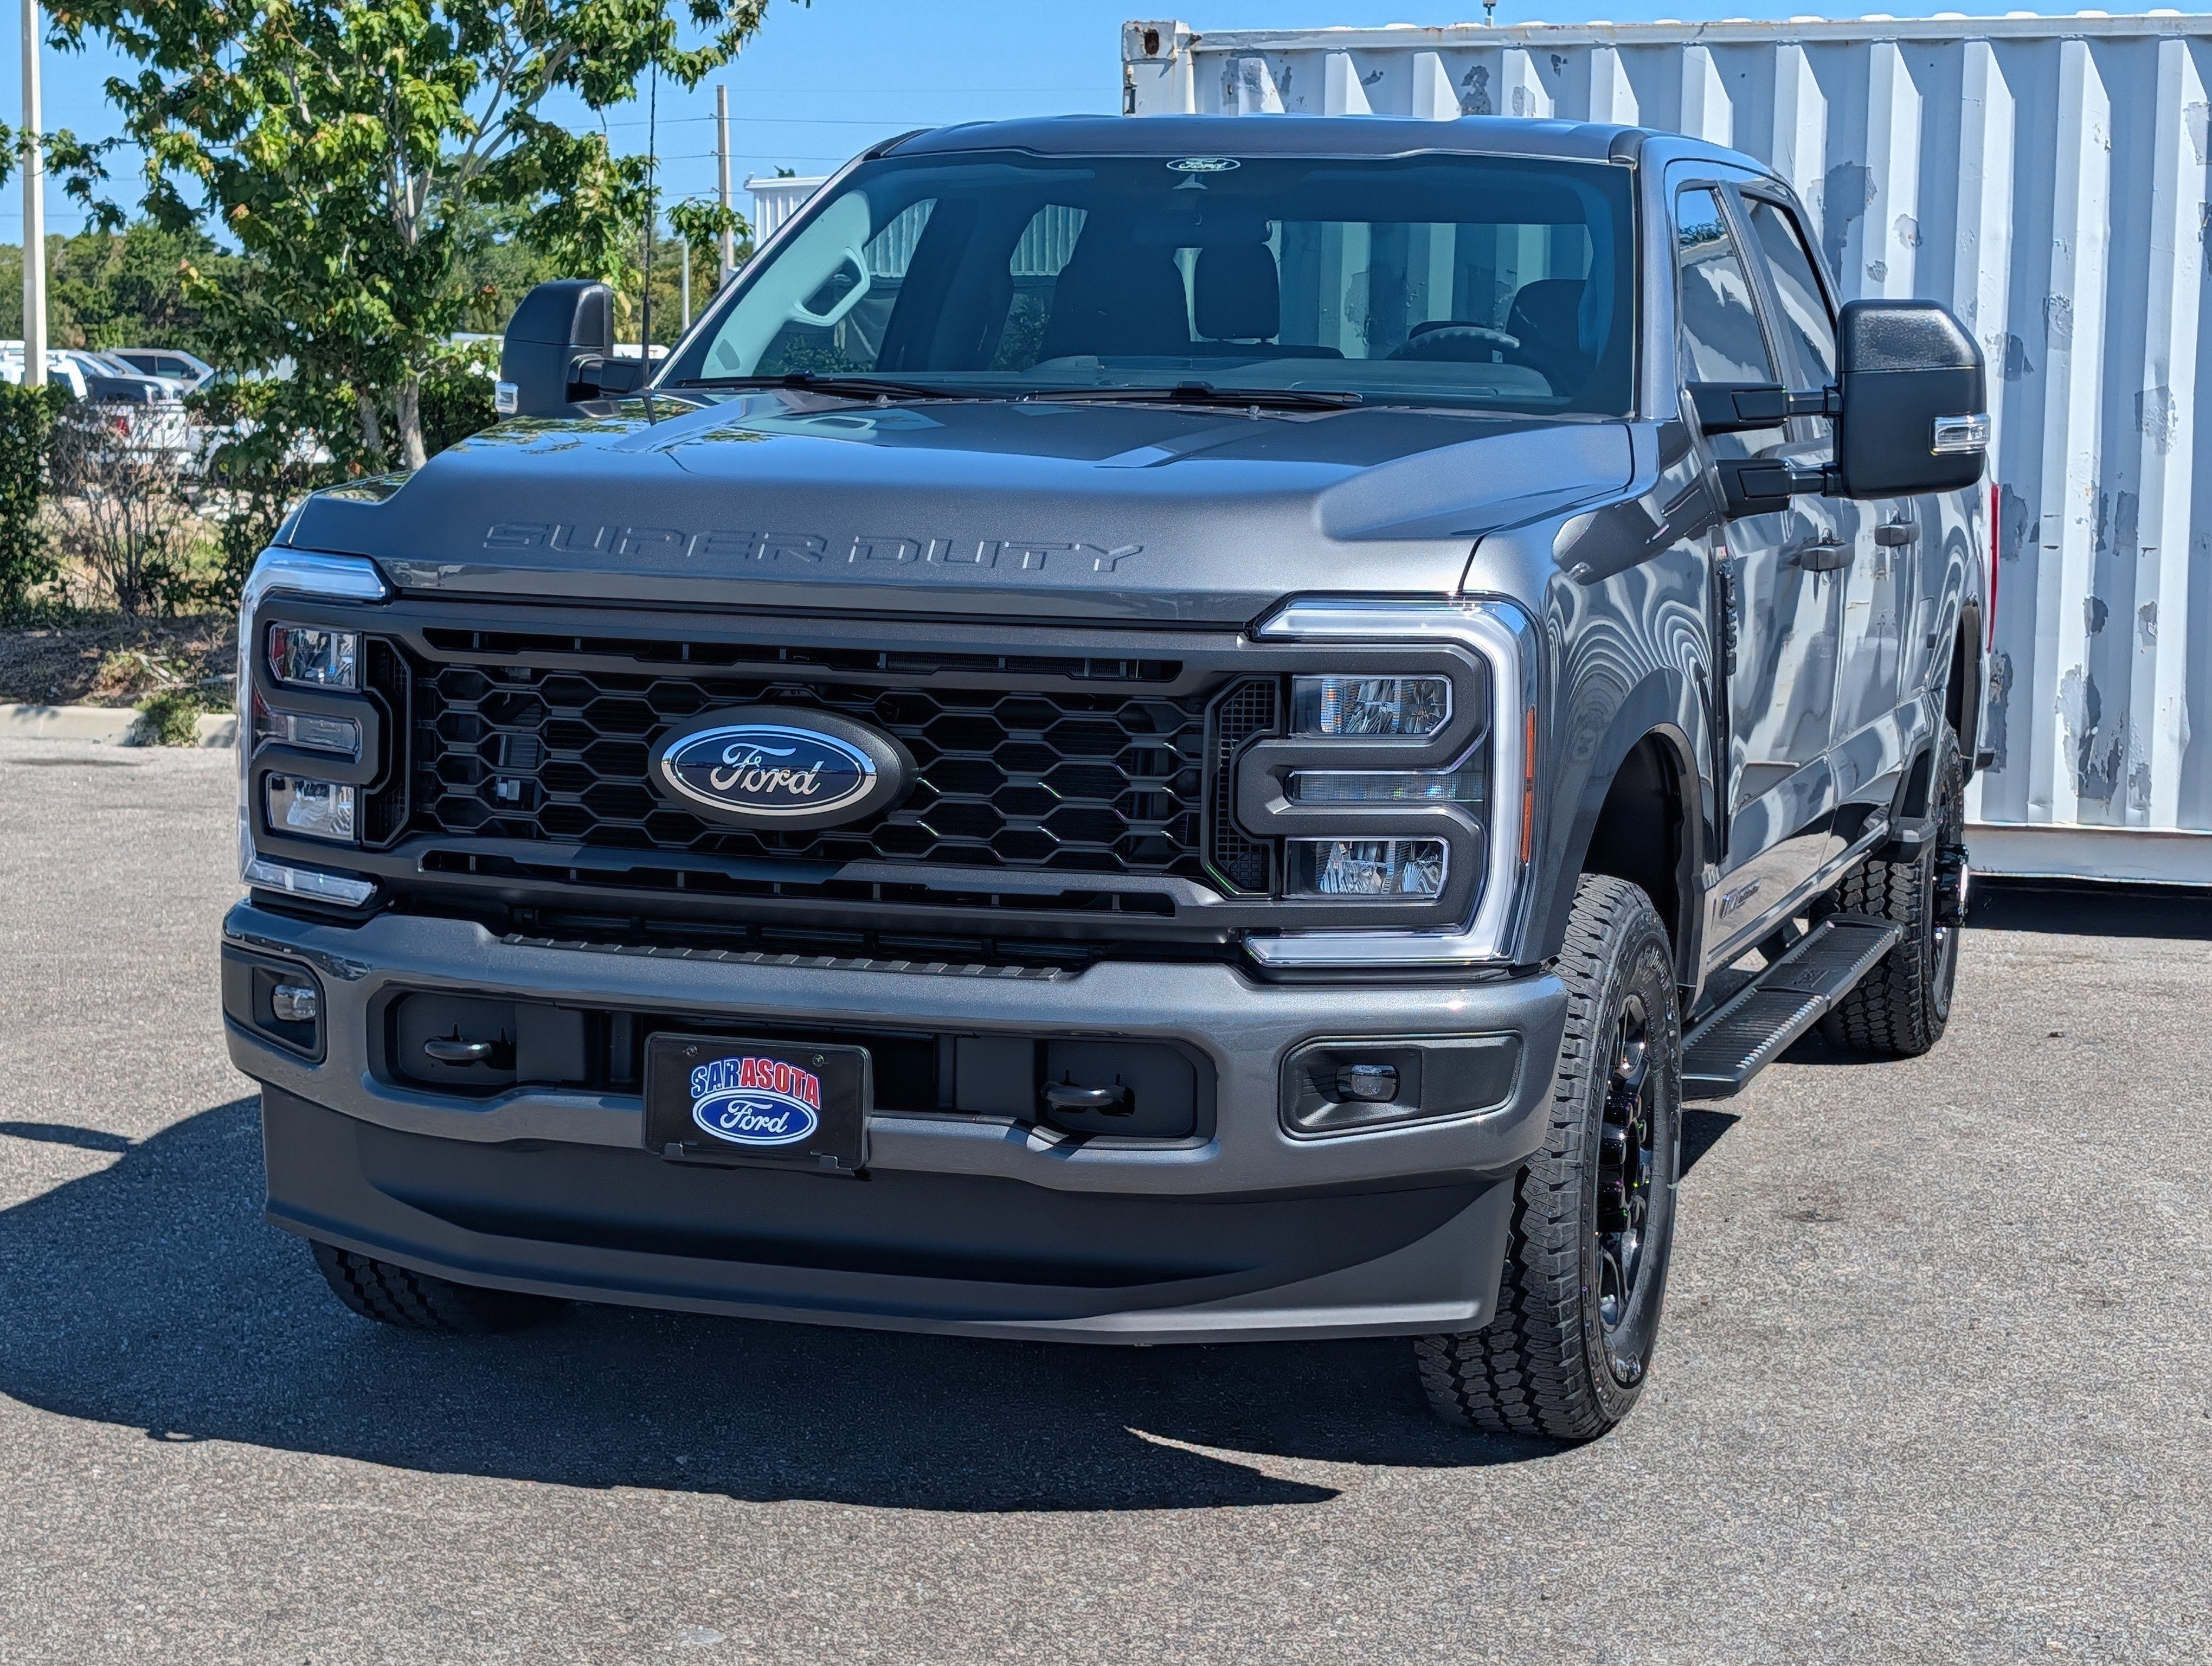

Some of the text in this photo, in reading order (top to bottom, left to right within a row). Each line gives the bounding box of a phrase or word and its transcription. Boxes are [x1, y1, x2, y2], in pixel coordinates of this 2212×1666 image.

[483, 522, 1144, 573] SUPER DUTY
[710, 742, 825, 795] Ford
[691, 1058, 821, 1110] SARASOTA
[720, 1099, 790, 1134] Ford
